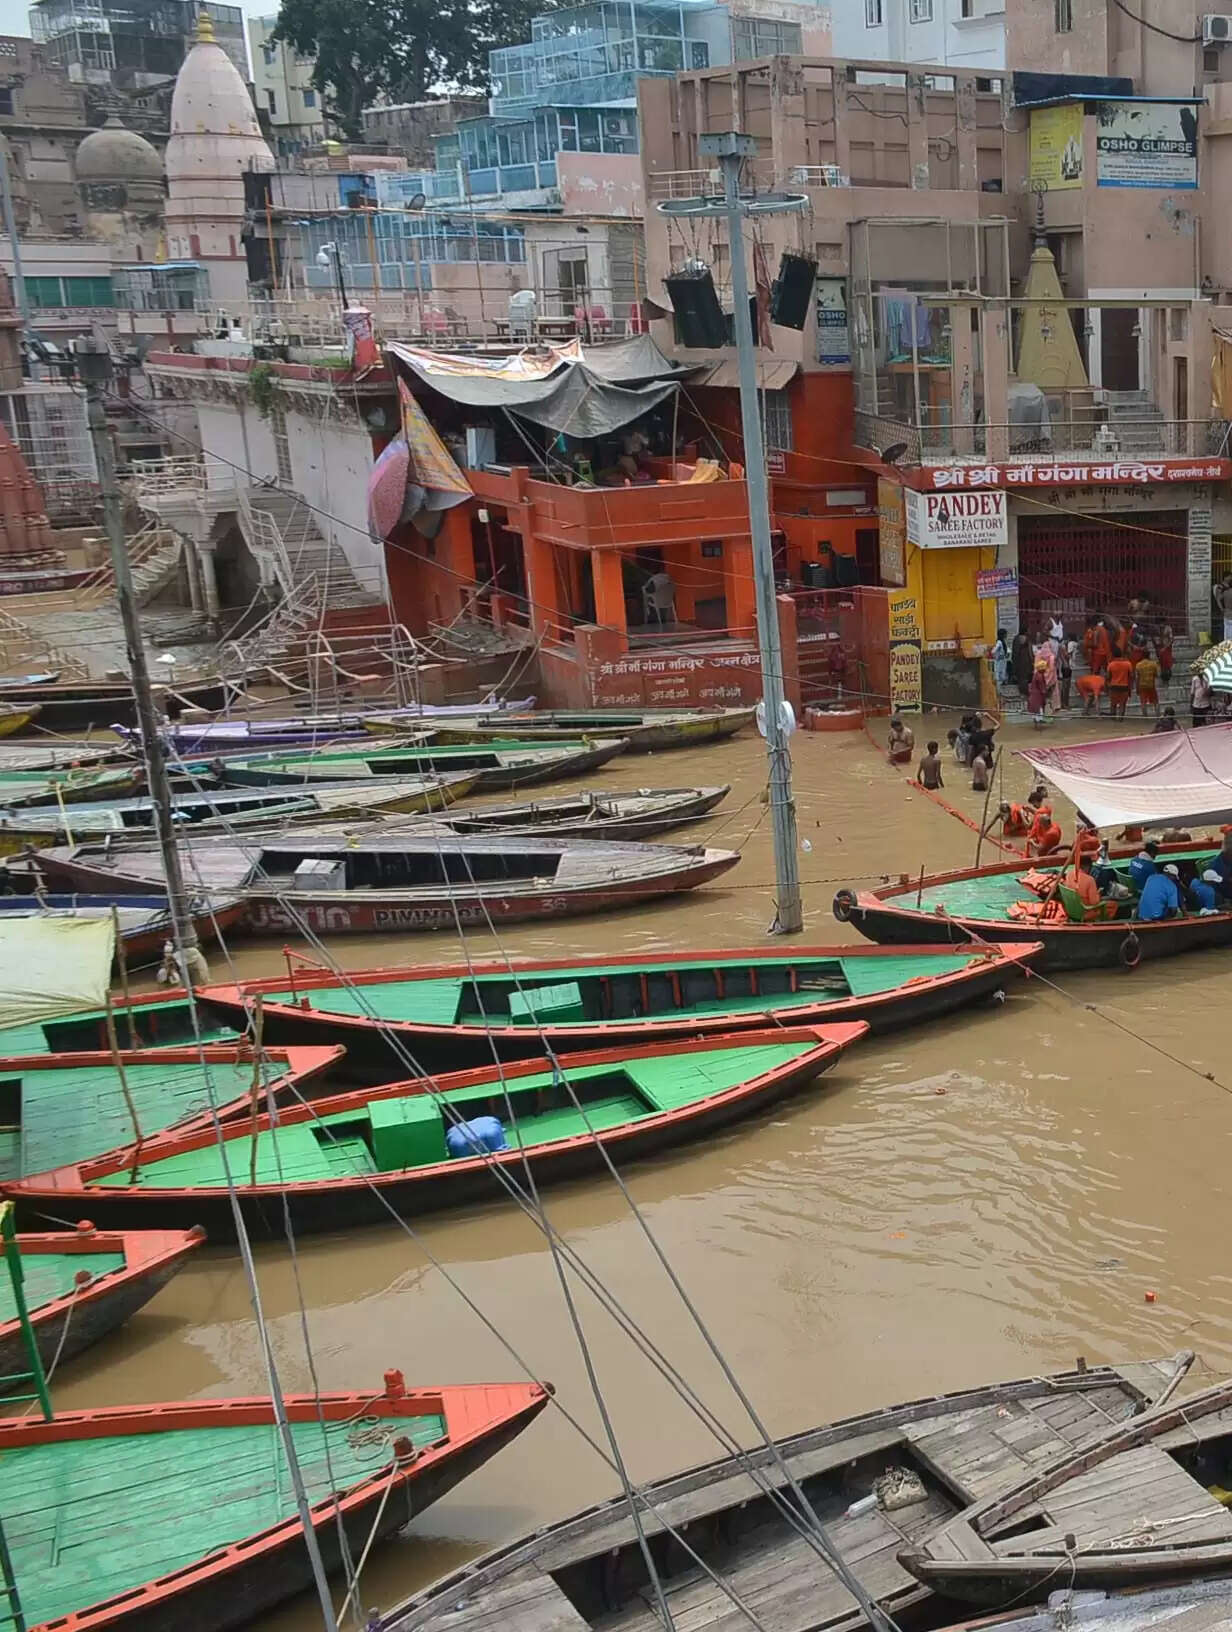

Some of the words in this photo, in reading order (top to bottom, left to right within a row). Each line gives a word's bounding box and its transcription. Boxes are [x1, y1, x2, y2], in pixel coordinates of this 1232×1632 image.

[1101, 138, 1138, 151] OSHO
[1141, 140, 1193, 153] GLIMPSE
[819, 311, 845, 320] OSHO
[927, 494, 1003, 518] PANDEY
[928, 521, 960, 533] SAREE
[962, 519, 1003, 530] FACTORY
[891, 652, 920, 667] PANDEY
[893, 669, 919, 684] SAREE
[892, 687, 920, 701] FACTORY
